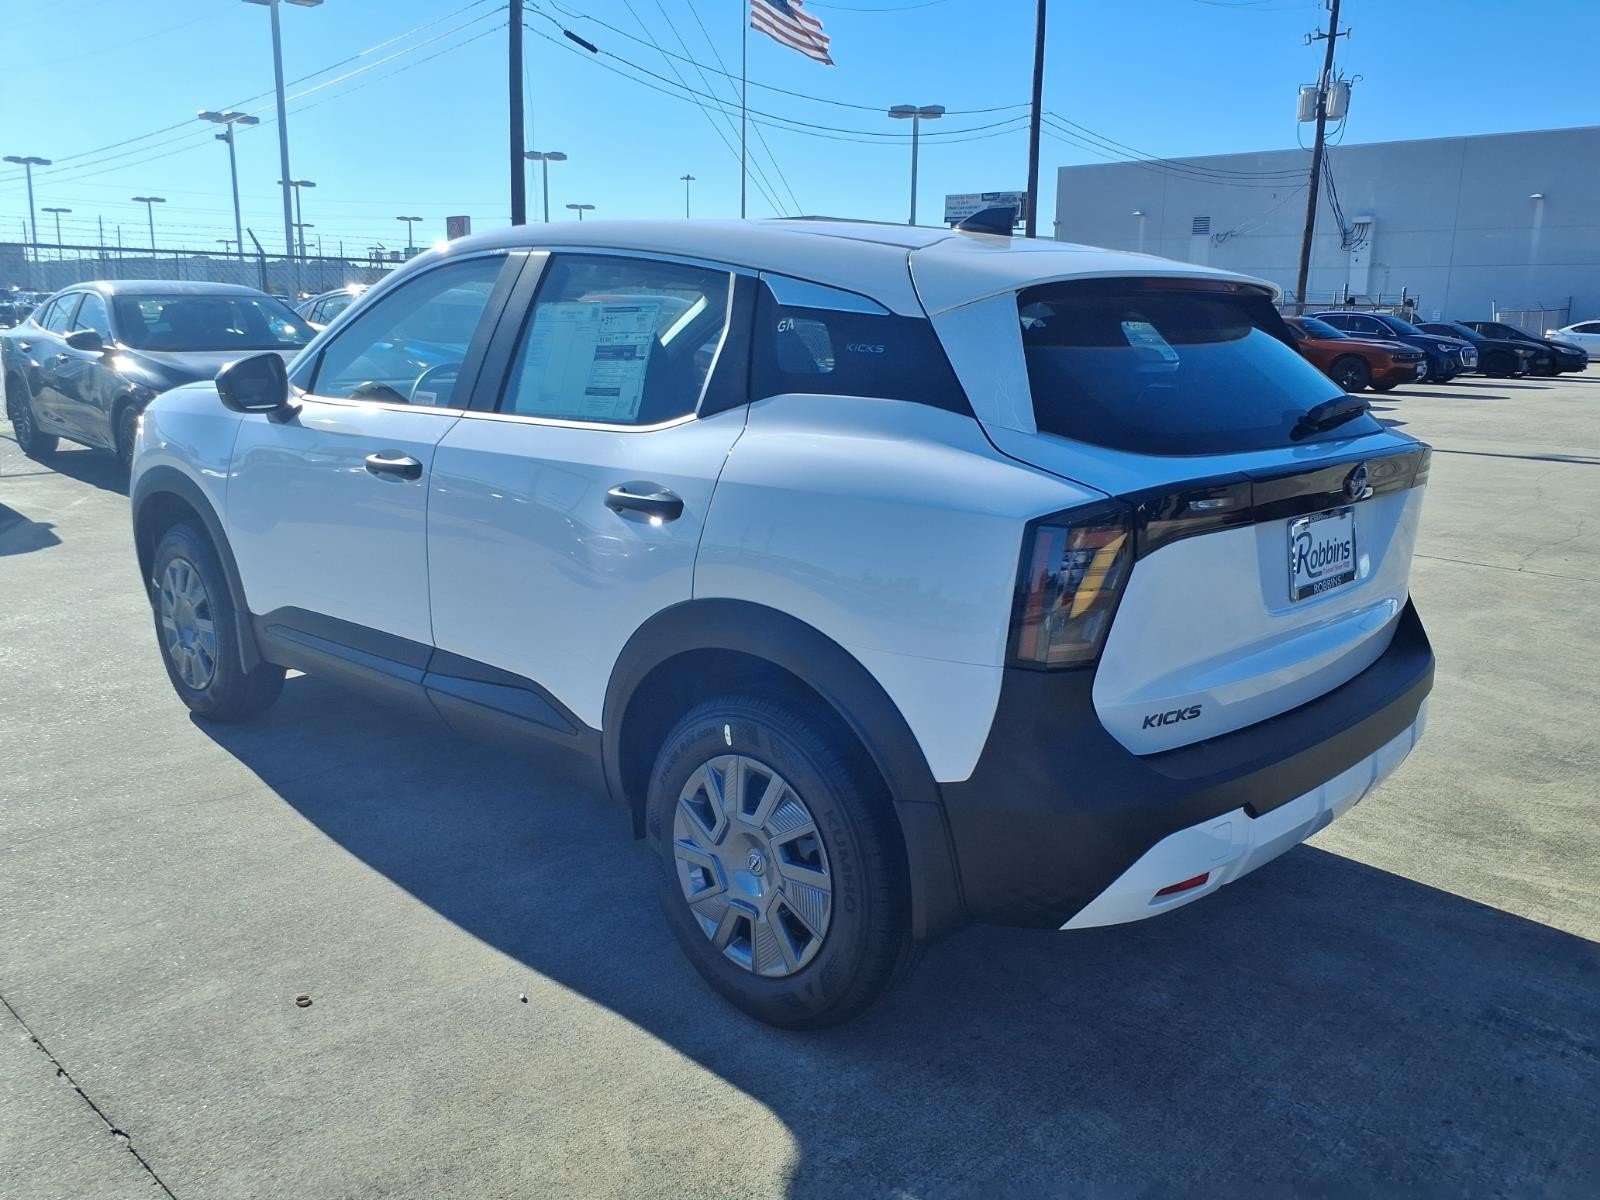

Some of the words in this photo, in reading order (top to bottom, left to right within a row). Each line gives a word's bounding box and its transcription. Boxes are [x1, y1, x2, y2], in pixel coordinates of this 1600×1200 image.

[846, 343, 885, 353] KICKS
[1296, 531, 1351, 579] Robbins
[1313, 575, 1342, 594] ROBBINS
[1142, 704, 1202, 730] KICKS
[825, 809, 856, 914] KUMHO
